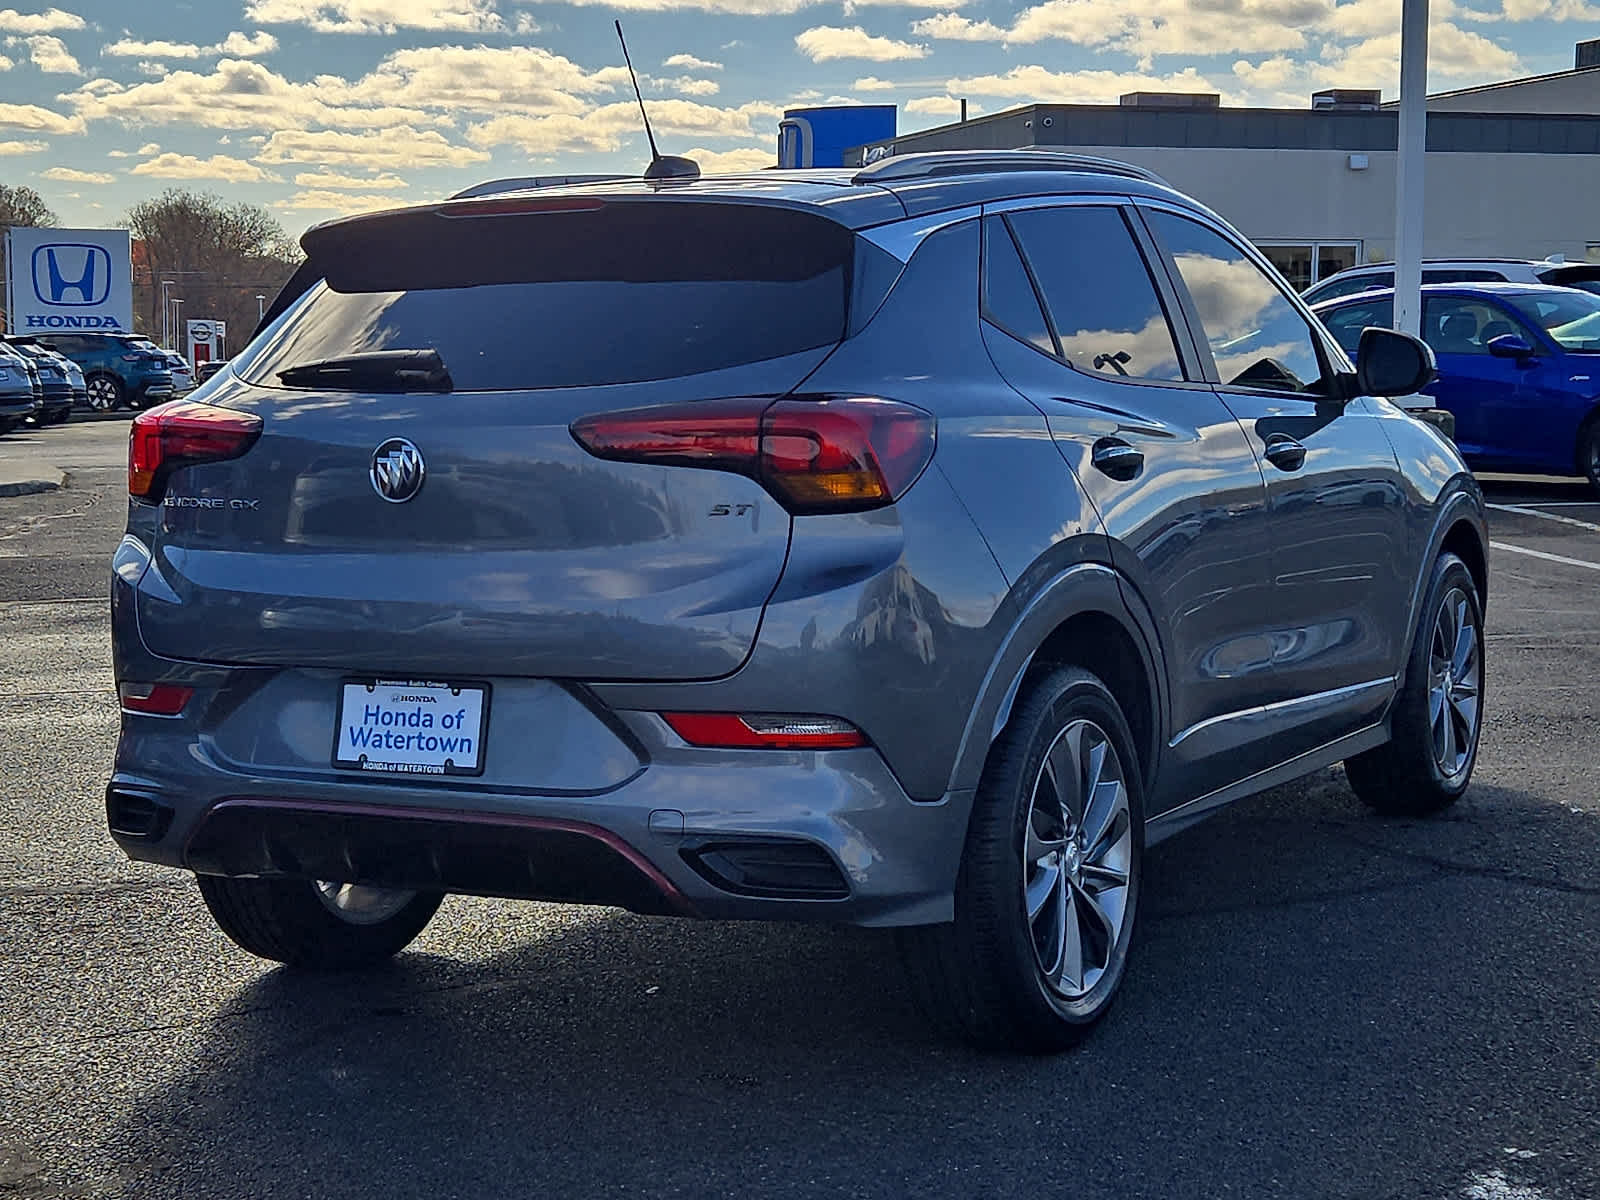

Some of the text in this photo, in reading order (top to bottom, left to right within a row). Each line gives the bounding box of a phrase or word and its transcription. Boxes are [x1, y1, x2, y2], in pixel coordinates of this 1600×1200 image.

[25, 314, 121, 328] HONDA
[229, 499, 259, 511] GX
[707, 503, 754, 517] ST
[400, 695, 437, 704] HONDA
[363, 704, 466, 730] Honda of
[349, 725, 473, 754] Watertown
[362, 761, 389, 771] HONDA
[397, 763, 445, 774] WATERTOWN
